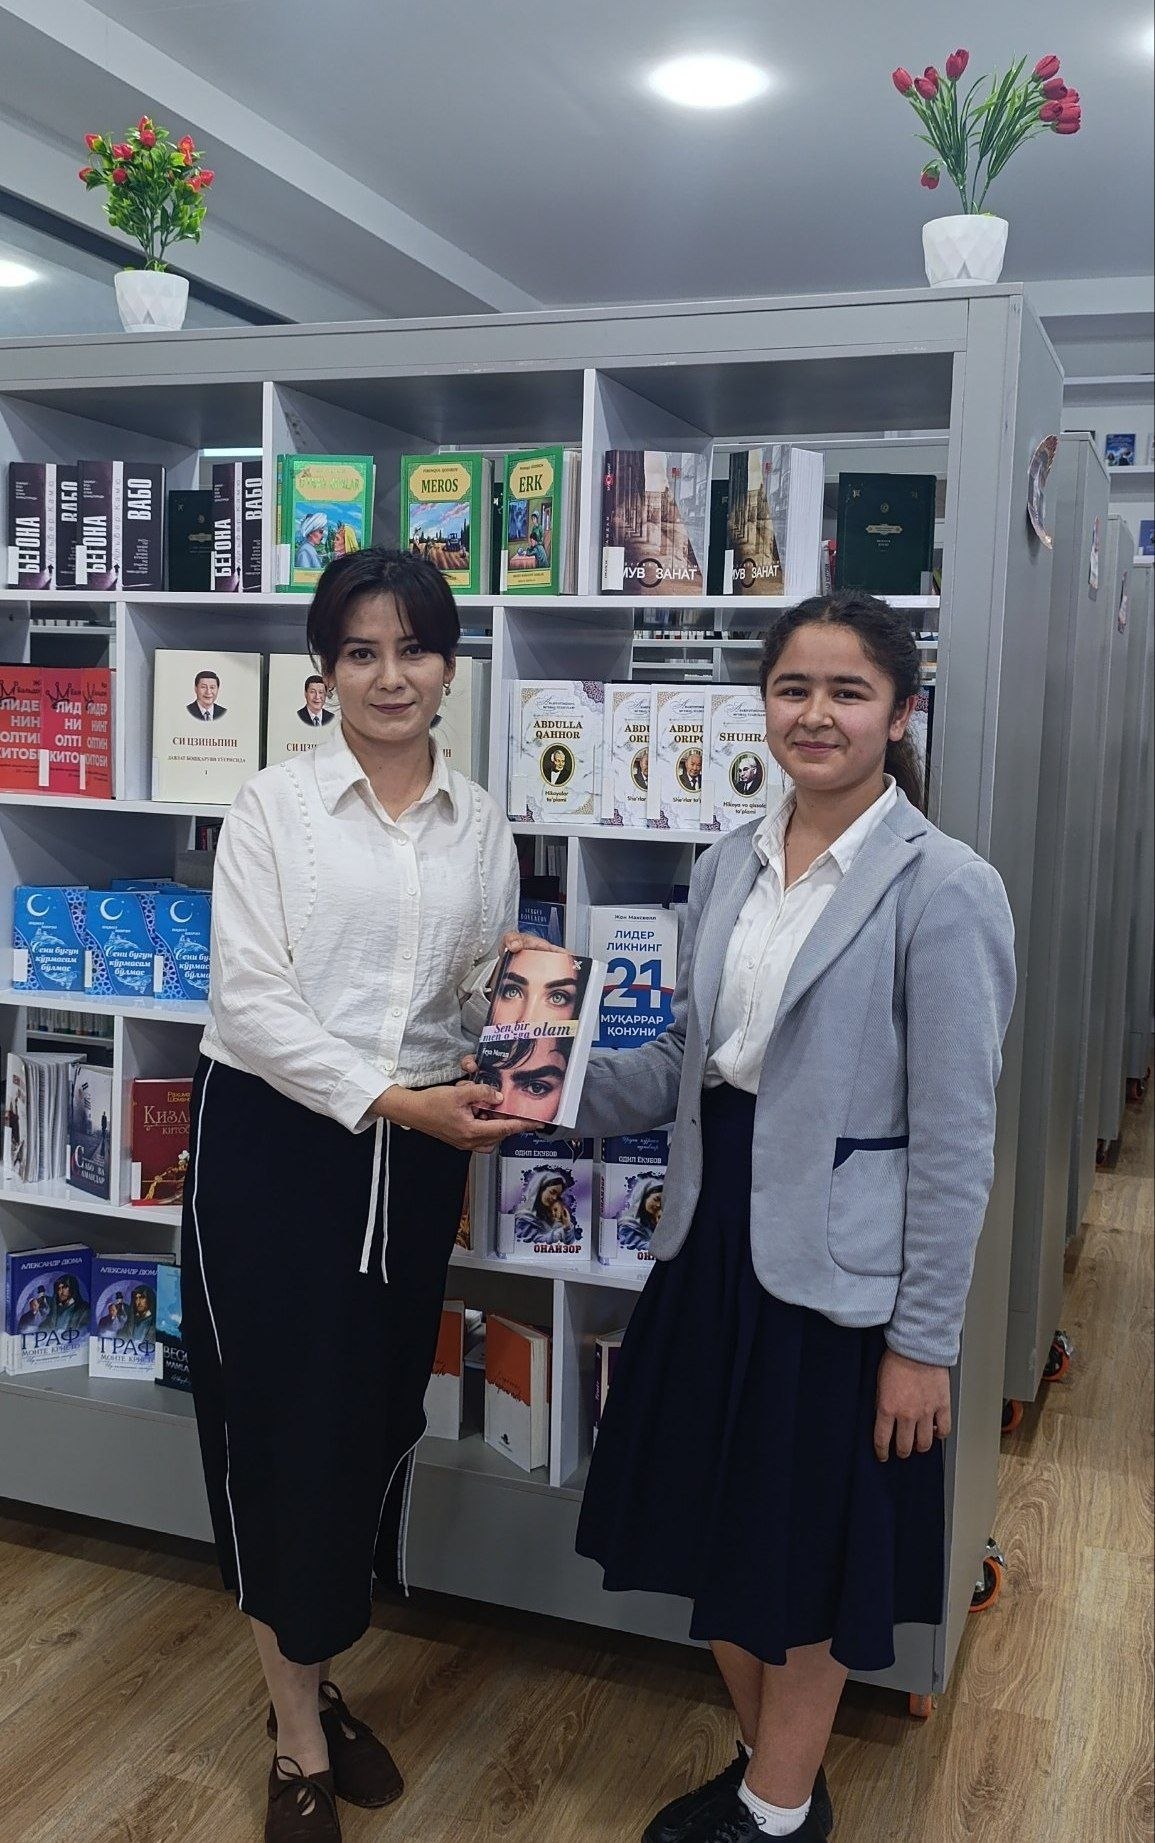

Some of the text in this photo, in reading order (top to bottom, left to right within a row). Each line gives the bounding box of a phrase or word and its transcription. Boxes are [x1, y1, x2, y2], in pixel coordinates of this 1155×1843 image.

[421, 478, 459, 493] MEROS
[519, 473, 543, 493] ERK
[127, 478, 152, 520] ВАБО
[214, 518, 232, 577] БЕГОНА
[0, 699, 40, 712] ЛИДЕ
[56, 702, 82, 715] ЛИД
[11, 715, 41, 727] НИН
[64, 719, 82, 731] НИ
[533, 720, 583, 729] ABDULLA
[535, 730, 581, 739] QAHHOR
[172, 737, 238, 748] СИ ЦЗИНЬПИН
[286, 742, 298, 752] СИ
[50, 750, 81, 764] КИТО
[614, 930, 655, 940] ЛИДЕР
[54, 946, 79, 955] бугун
[606, 942, 662, 952] ЛИКНИНГ
[128, 951, 153, 959] бугун
[40, 963, 71, 972] бўлмас
[109, 959, 152, 968] кўрмасам
[114, 967, 146, 976] бўлмас
[603, 957, 662, 1009] 21
[600, 1014, 664, 1026] МУҚАРРАР
[494, 1020, 530, 1034] Sen bir
[533, 1021, 571, 1037] olam
[607, 1026, 656, 1037] ҚОНУНИ
[533, 1242, 582, 1254] ОНАЙЗОР
[21, 1257, 83, 1270] АЛЕКСАНДР ДЮМА
[100, 1267, 139, 1276] АЛЕКСАНДР
[21, 1328, 80, 1350] ГРАФ
[97, 1337, 156, 1357] ГРАФ
